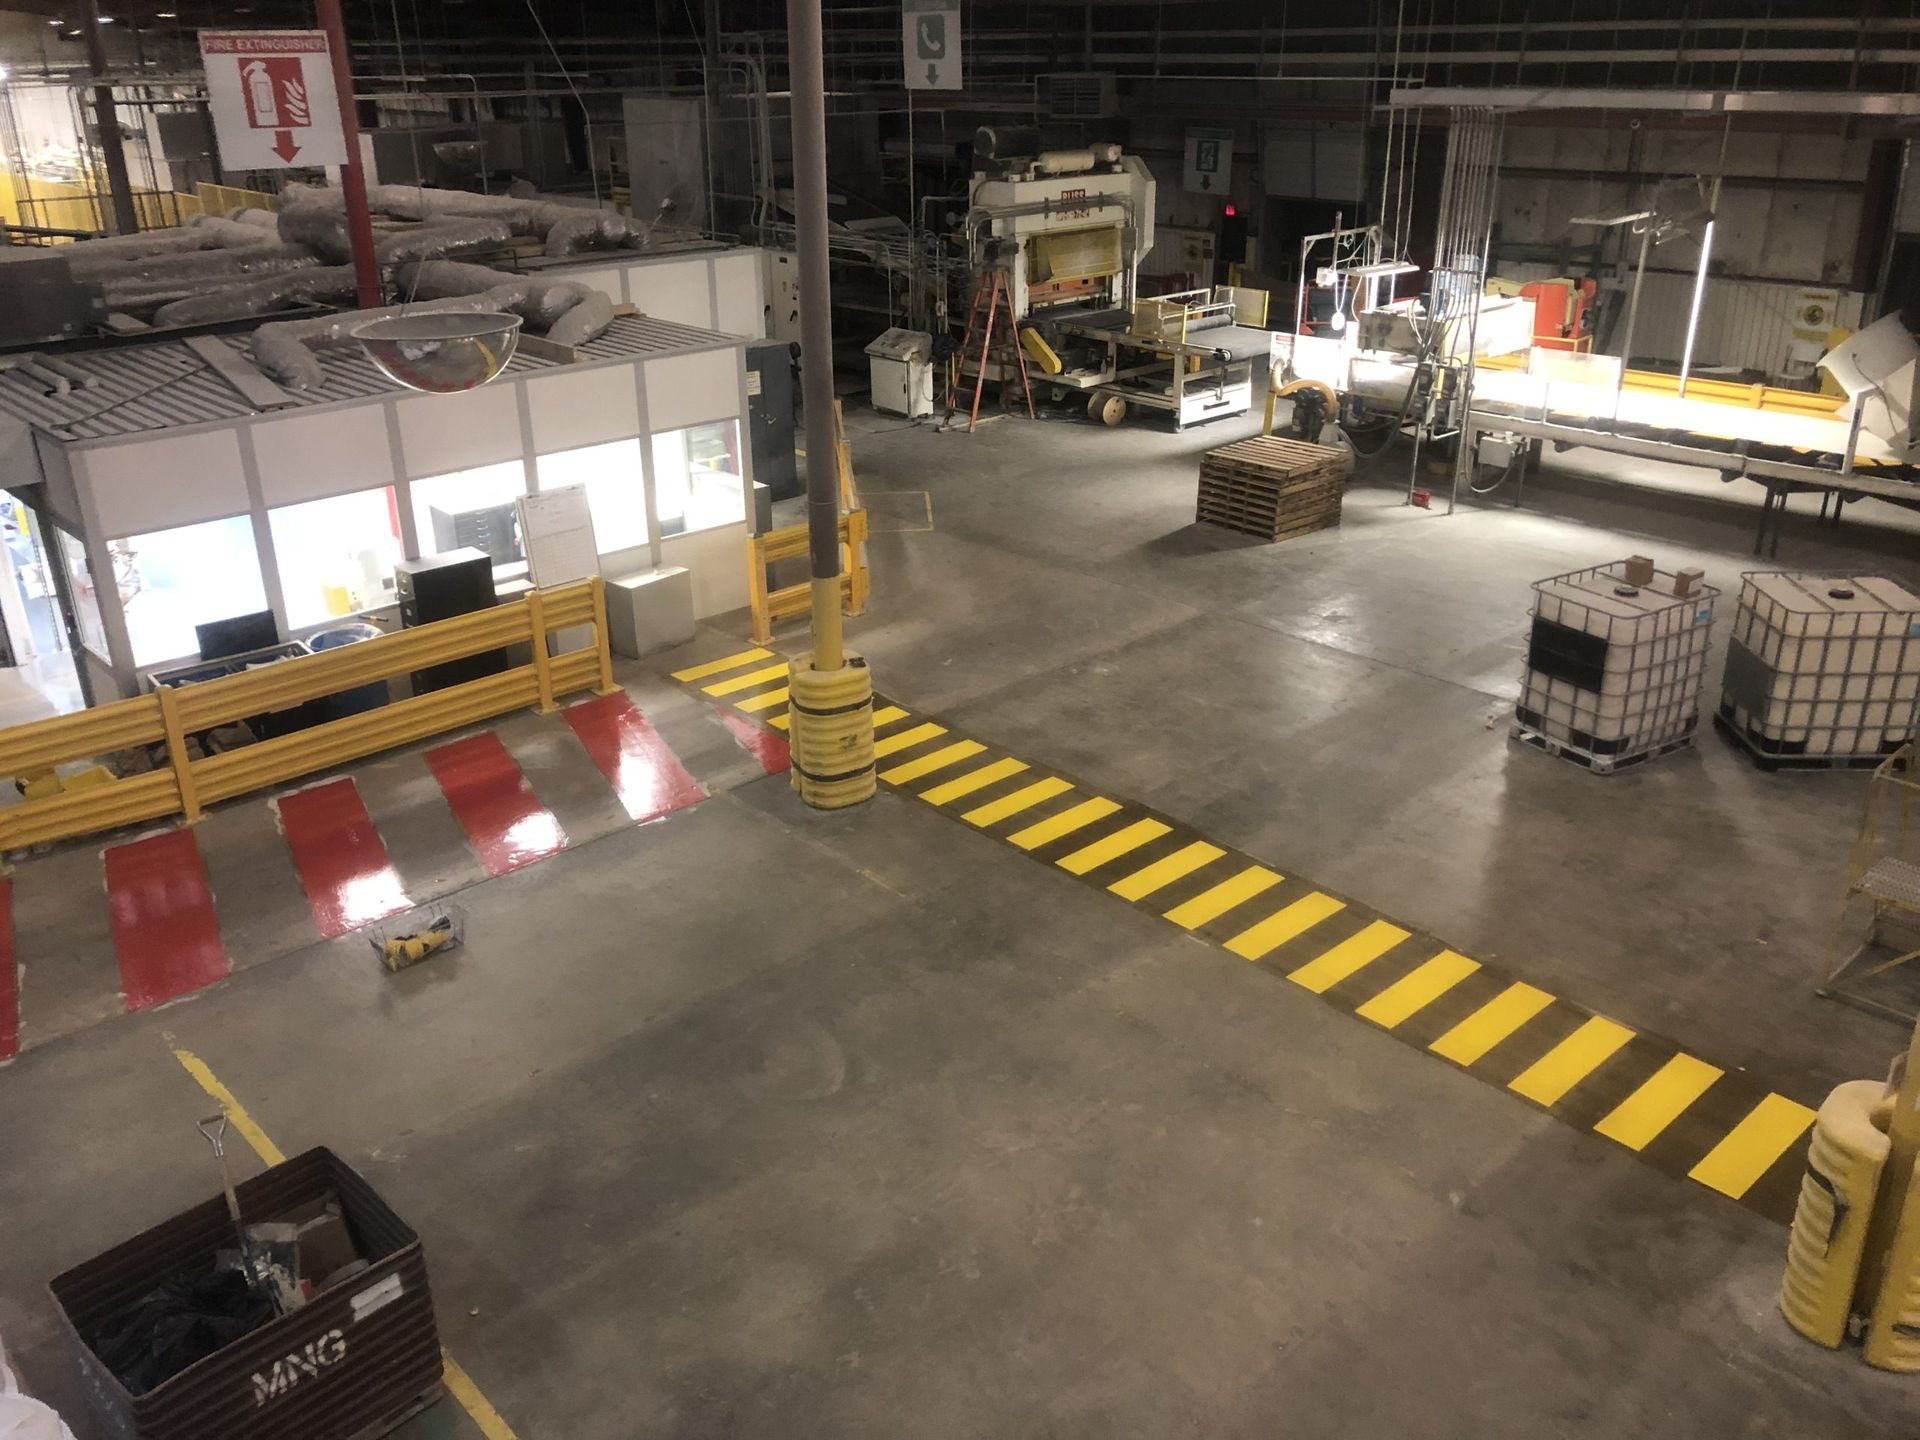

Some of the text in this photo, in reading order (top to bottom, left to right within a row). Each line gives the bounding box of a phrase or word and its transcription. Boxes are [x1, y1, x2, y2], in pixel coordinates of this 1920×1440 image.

[205, 38, 326, 50] FIRE EXTINGUISHER
[251, 1328, 347, 1408] MNG
